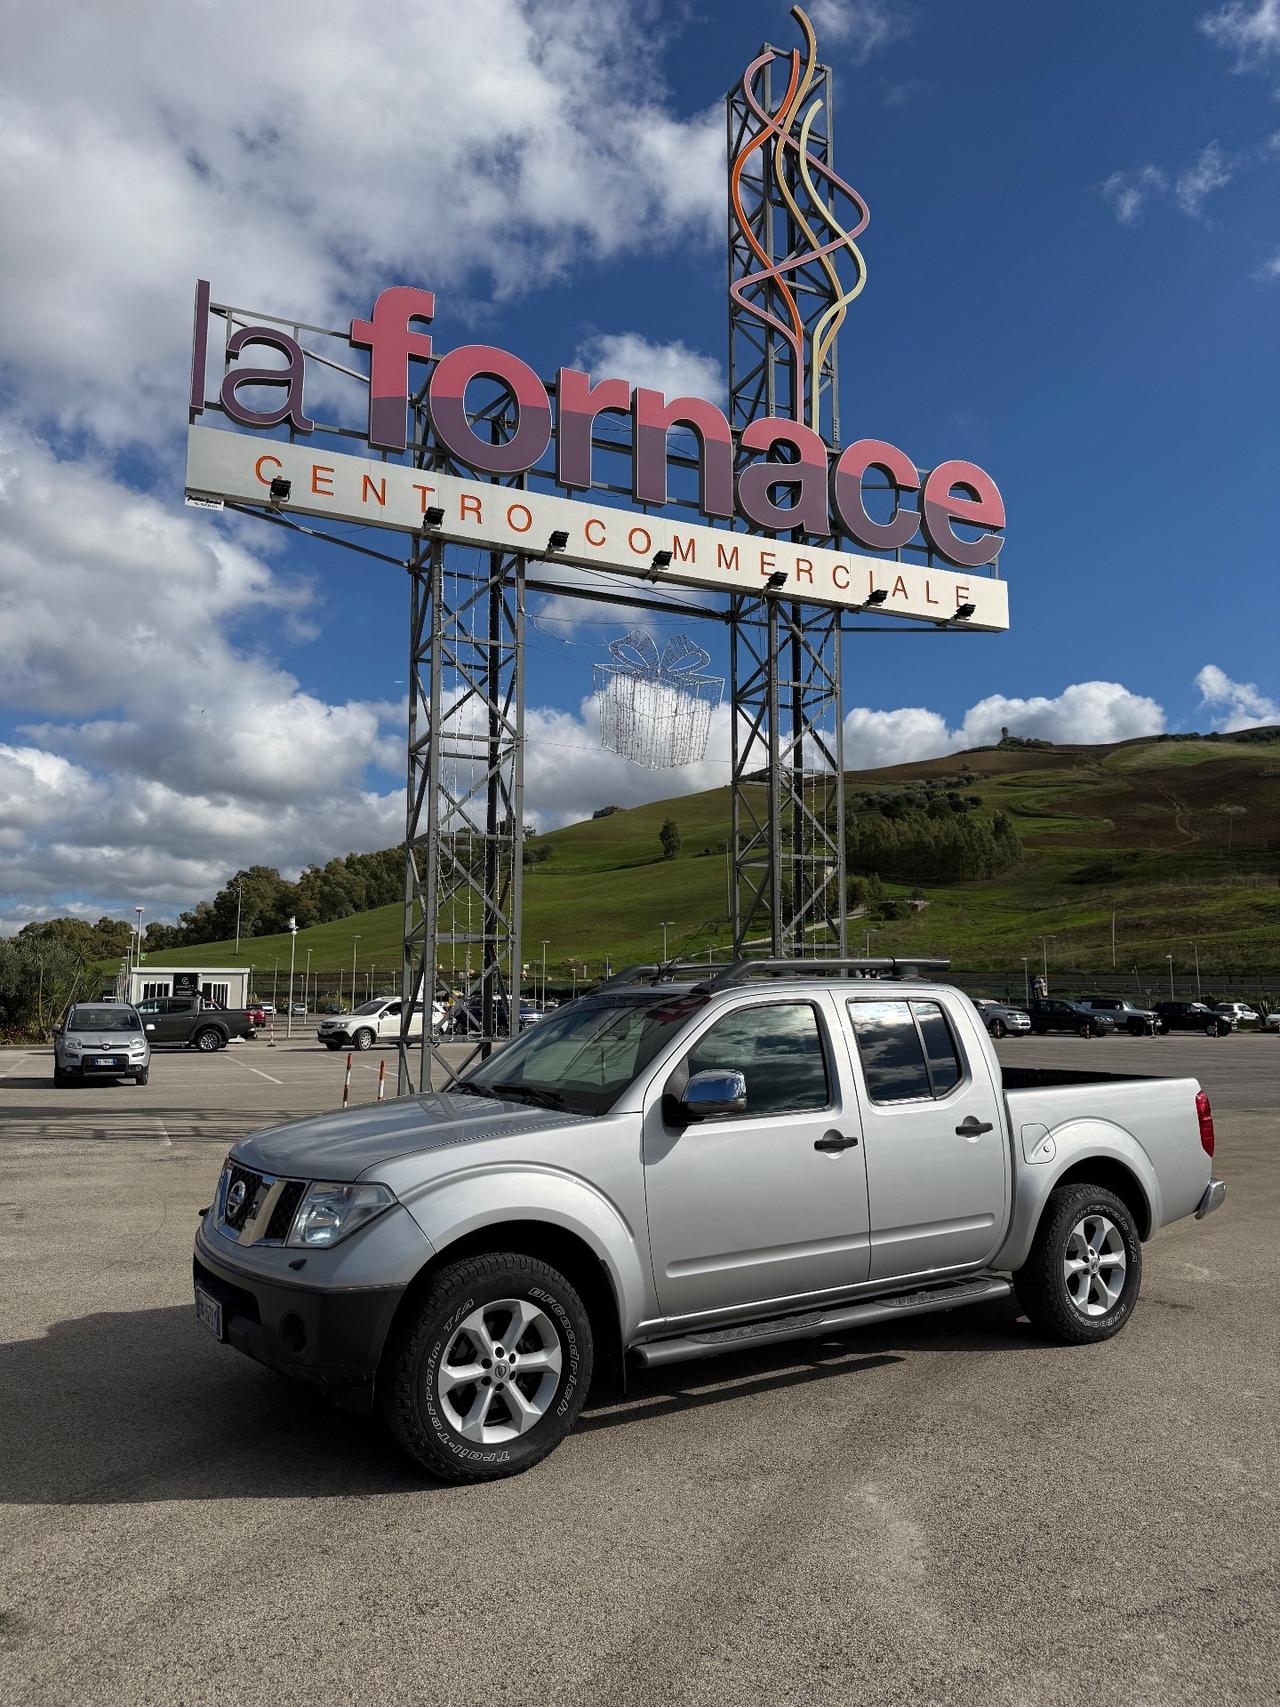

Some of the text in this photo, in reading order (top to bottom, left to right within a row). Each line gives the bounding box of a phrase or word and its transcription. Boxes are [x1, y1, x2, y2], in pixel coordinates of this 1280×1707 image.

[190, 279, 1006, 567] la fornace
[255, 455, 971, 608] CENTRO COMMERCIALE
[424, 1299, 510, 1462] Trail-Terrain T/A
[528, 1287, 580, 1416] BFGoodrich
